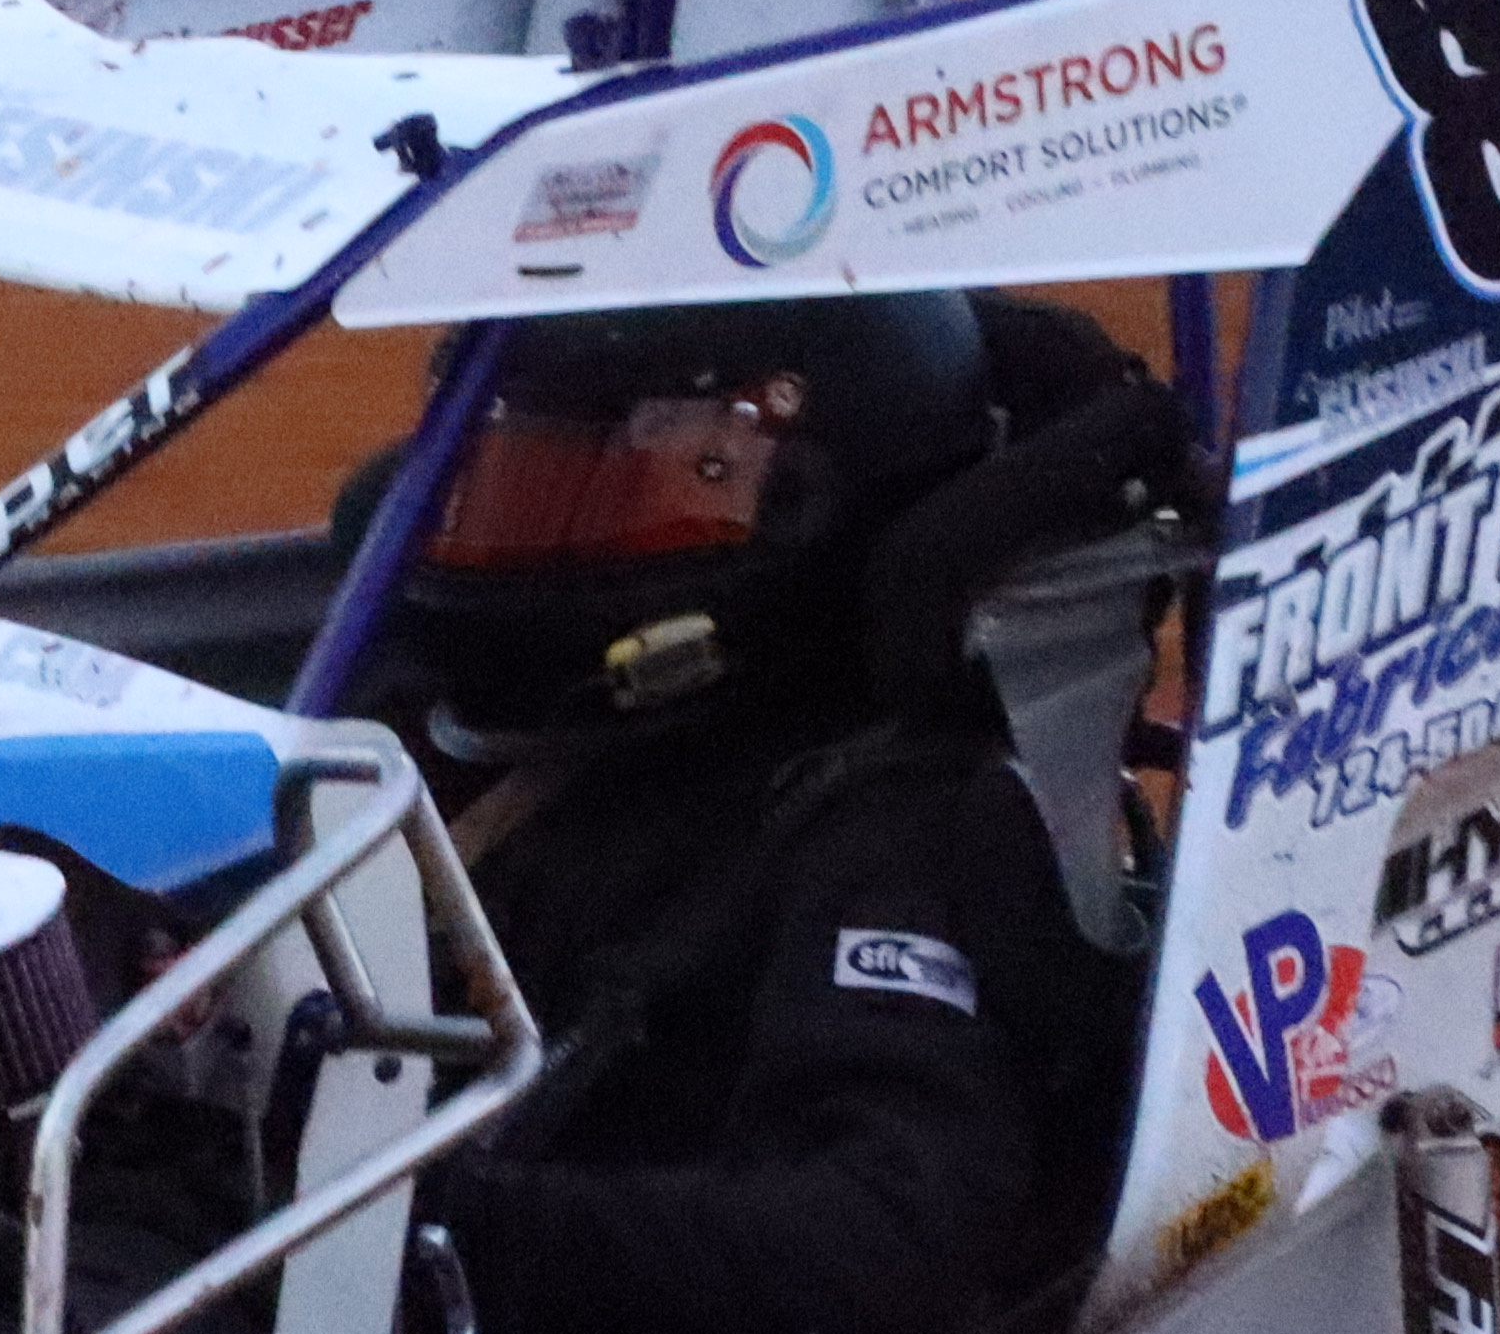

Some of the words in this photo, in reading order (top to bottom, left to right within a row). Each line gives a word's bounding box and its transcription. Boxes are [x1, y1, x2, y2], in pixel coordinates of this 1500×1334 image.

[861, 23, 1227, 156] ARMSTRONG
[862, 155, 1029, 211] COMFORT
[1194, 909, 1325, 1143] VP
